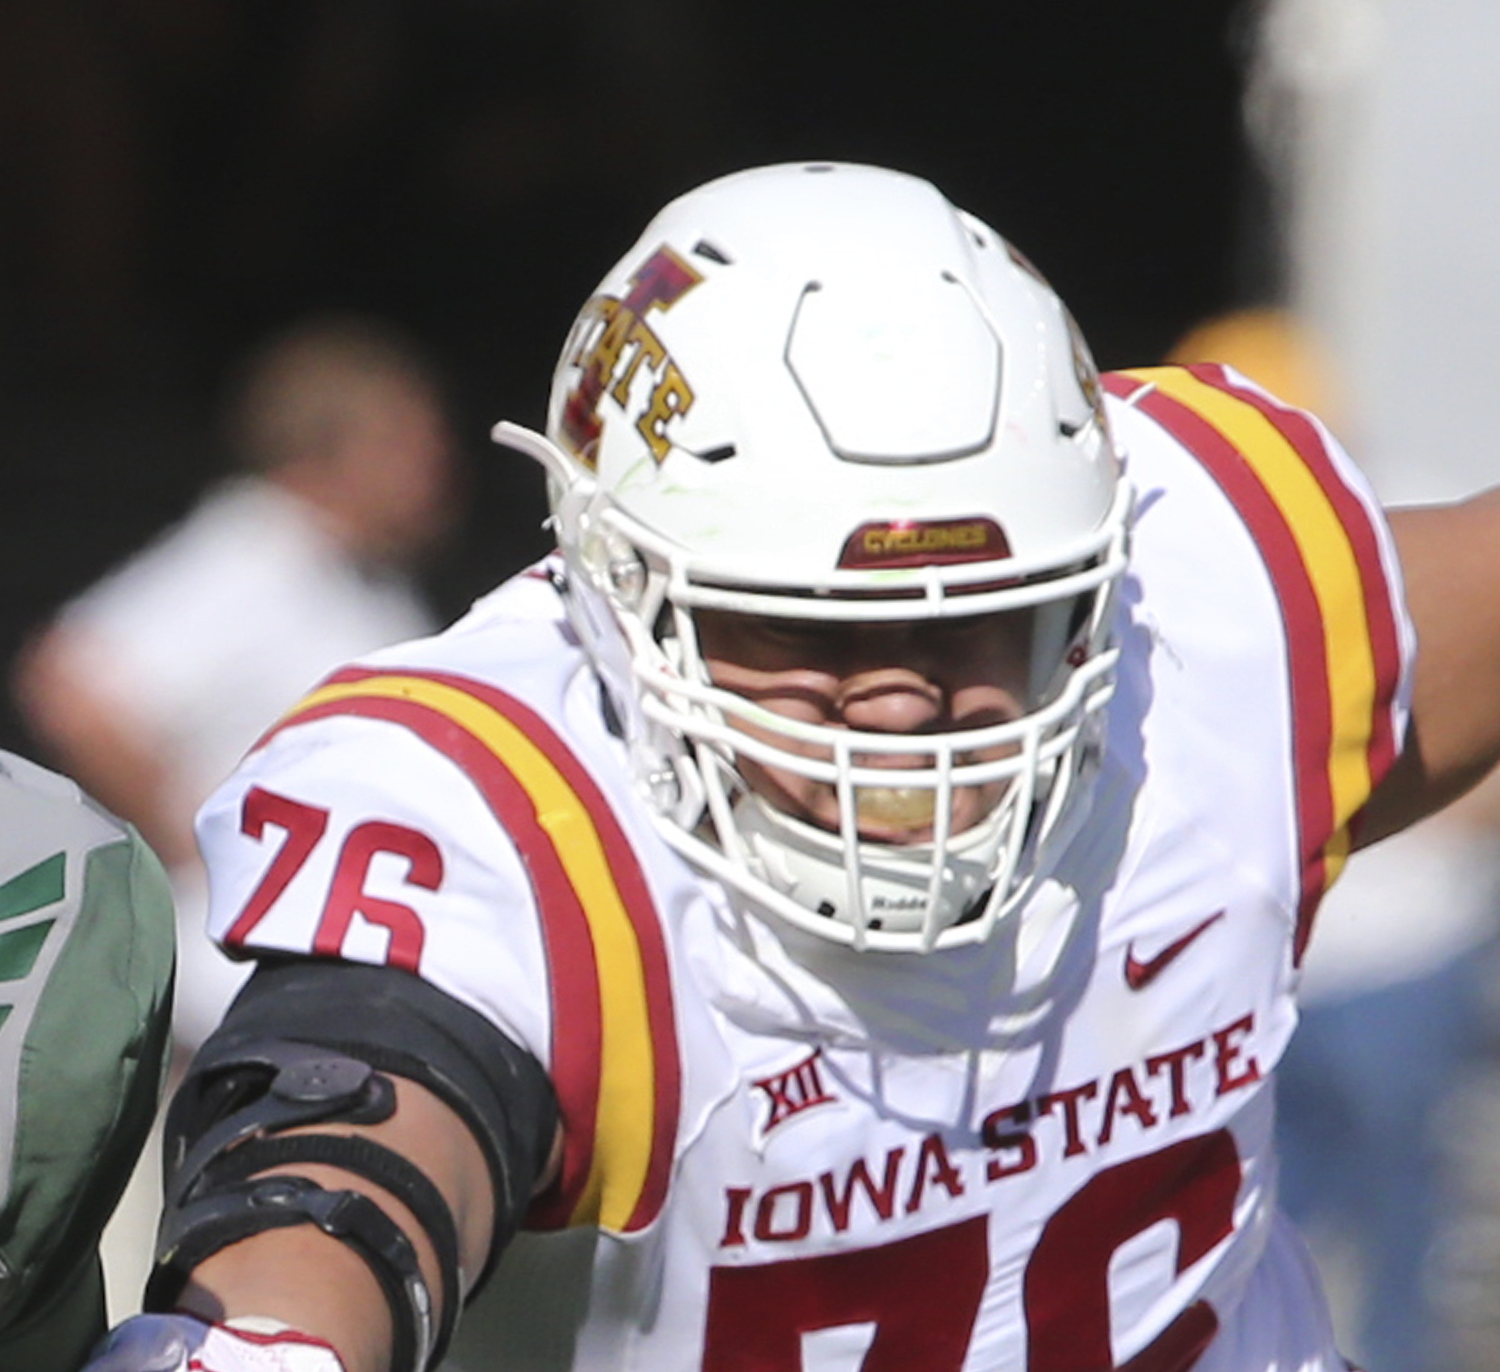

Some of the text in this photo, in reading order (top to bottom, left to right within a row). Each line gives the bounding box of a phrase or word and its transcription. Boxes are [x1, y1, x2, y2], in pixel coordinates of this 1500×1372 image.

[223, 783, 445, 976] 76
[719, 1012, 1261, 1248] IOWA STATE
